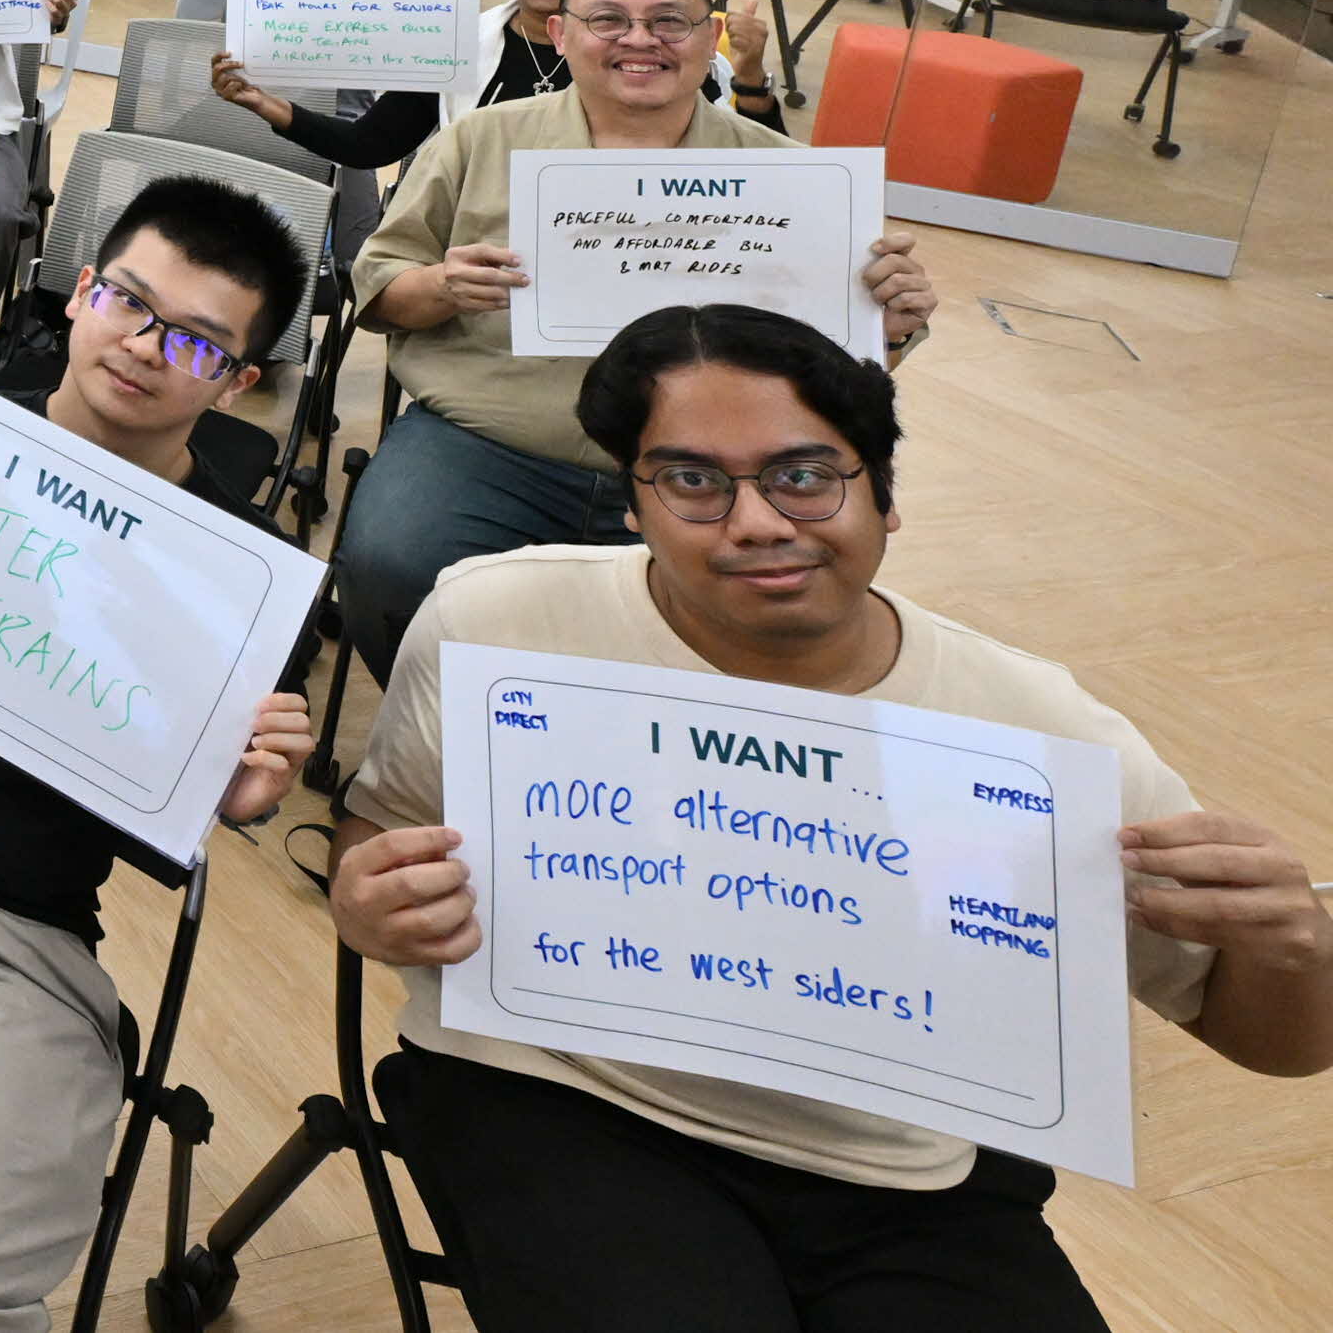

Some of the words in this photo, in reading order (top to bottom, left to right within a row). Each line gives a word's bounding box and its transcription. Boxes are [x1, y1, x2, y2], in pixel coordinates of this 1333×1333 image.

[352, 1, 381, 11] FOR
[393, 1, 453, 13] SENIORS
[264, 21, 309, 33] MORE
[324, 22, 389, 33] EXPRESS
[273, 34, 303, 46] AND
[272, 52, 334, 62] AIRPORT
[348, 54, 373, 64] 24
[637, 178, 643, 197] I
[661, 178, 746, 198] WANT
[665, 212, 791, 229] COMFORTABLE
[573, 238, 601, 250] AND
[614, 237, 717, 251] AFFORDABLE
[739, 240, 773, 253] BUS
[639, 260, 672, 273] MRT
[687, 261, 742, 275] RIDES
[4, 454, 20, 480] I
[36, 468, 143, 542] WANT
[501, 690, 533, 706] CITY
[494, 710, 548, 733] DIRECT
[650, 721, 660, 754] I
[689, 726, 843, 783] WANT
[972, 782, 1053, 815] EXPRESS
[525, 778, 633, 826] more
[673, 789, 911, 876] alternative
[524, 840, 687, 894] transport
[707, 871, 863, 926] options
[948, 894, 1056, 932] HEARTLAND
[950, 918, 1050, 959] HOPPING
[533, 931, 587, 967] for
[604, 933, 663, 973] the
[690, 950, 773, 991] west
[794, 967, 934, 1033] siders!
